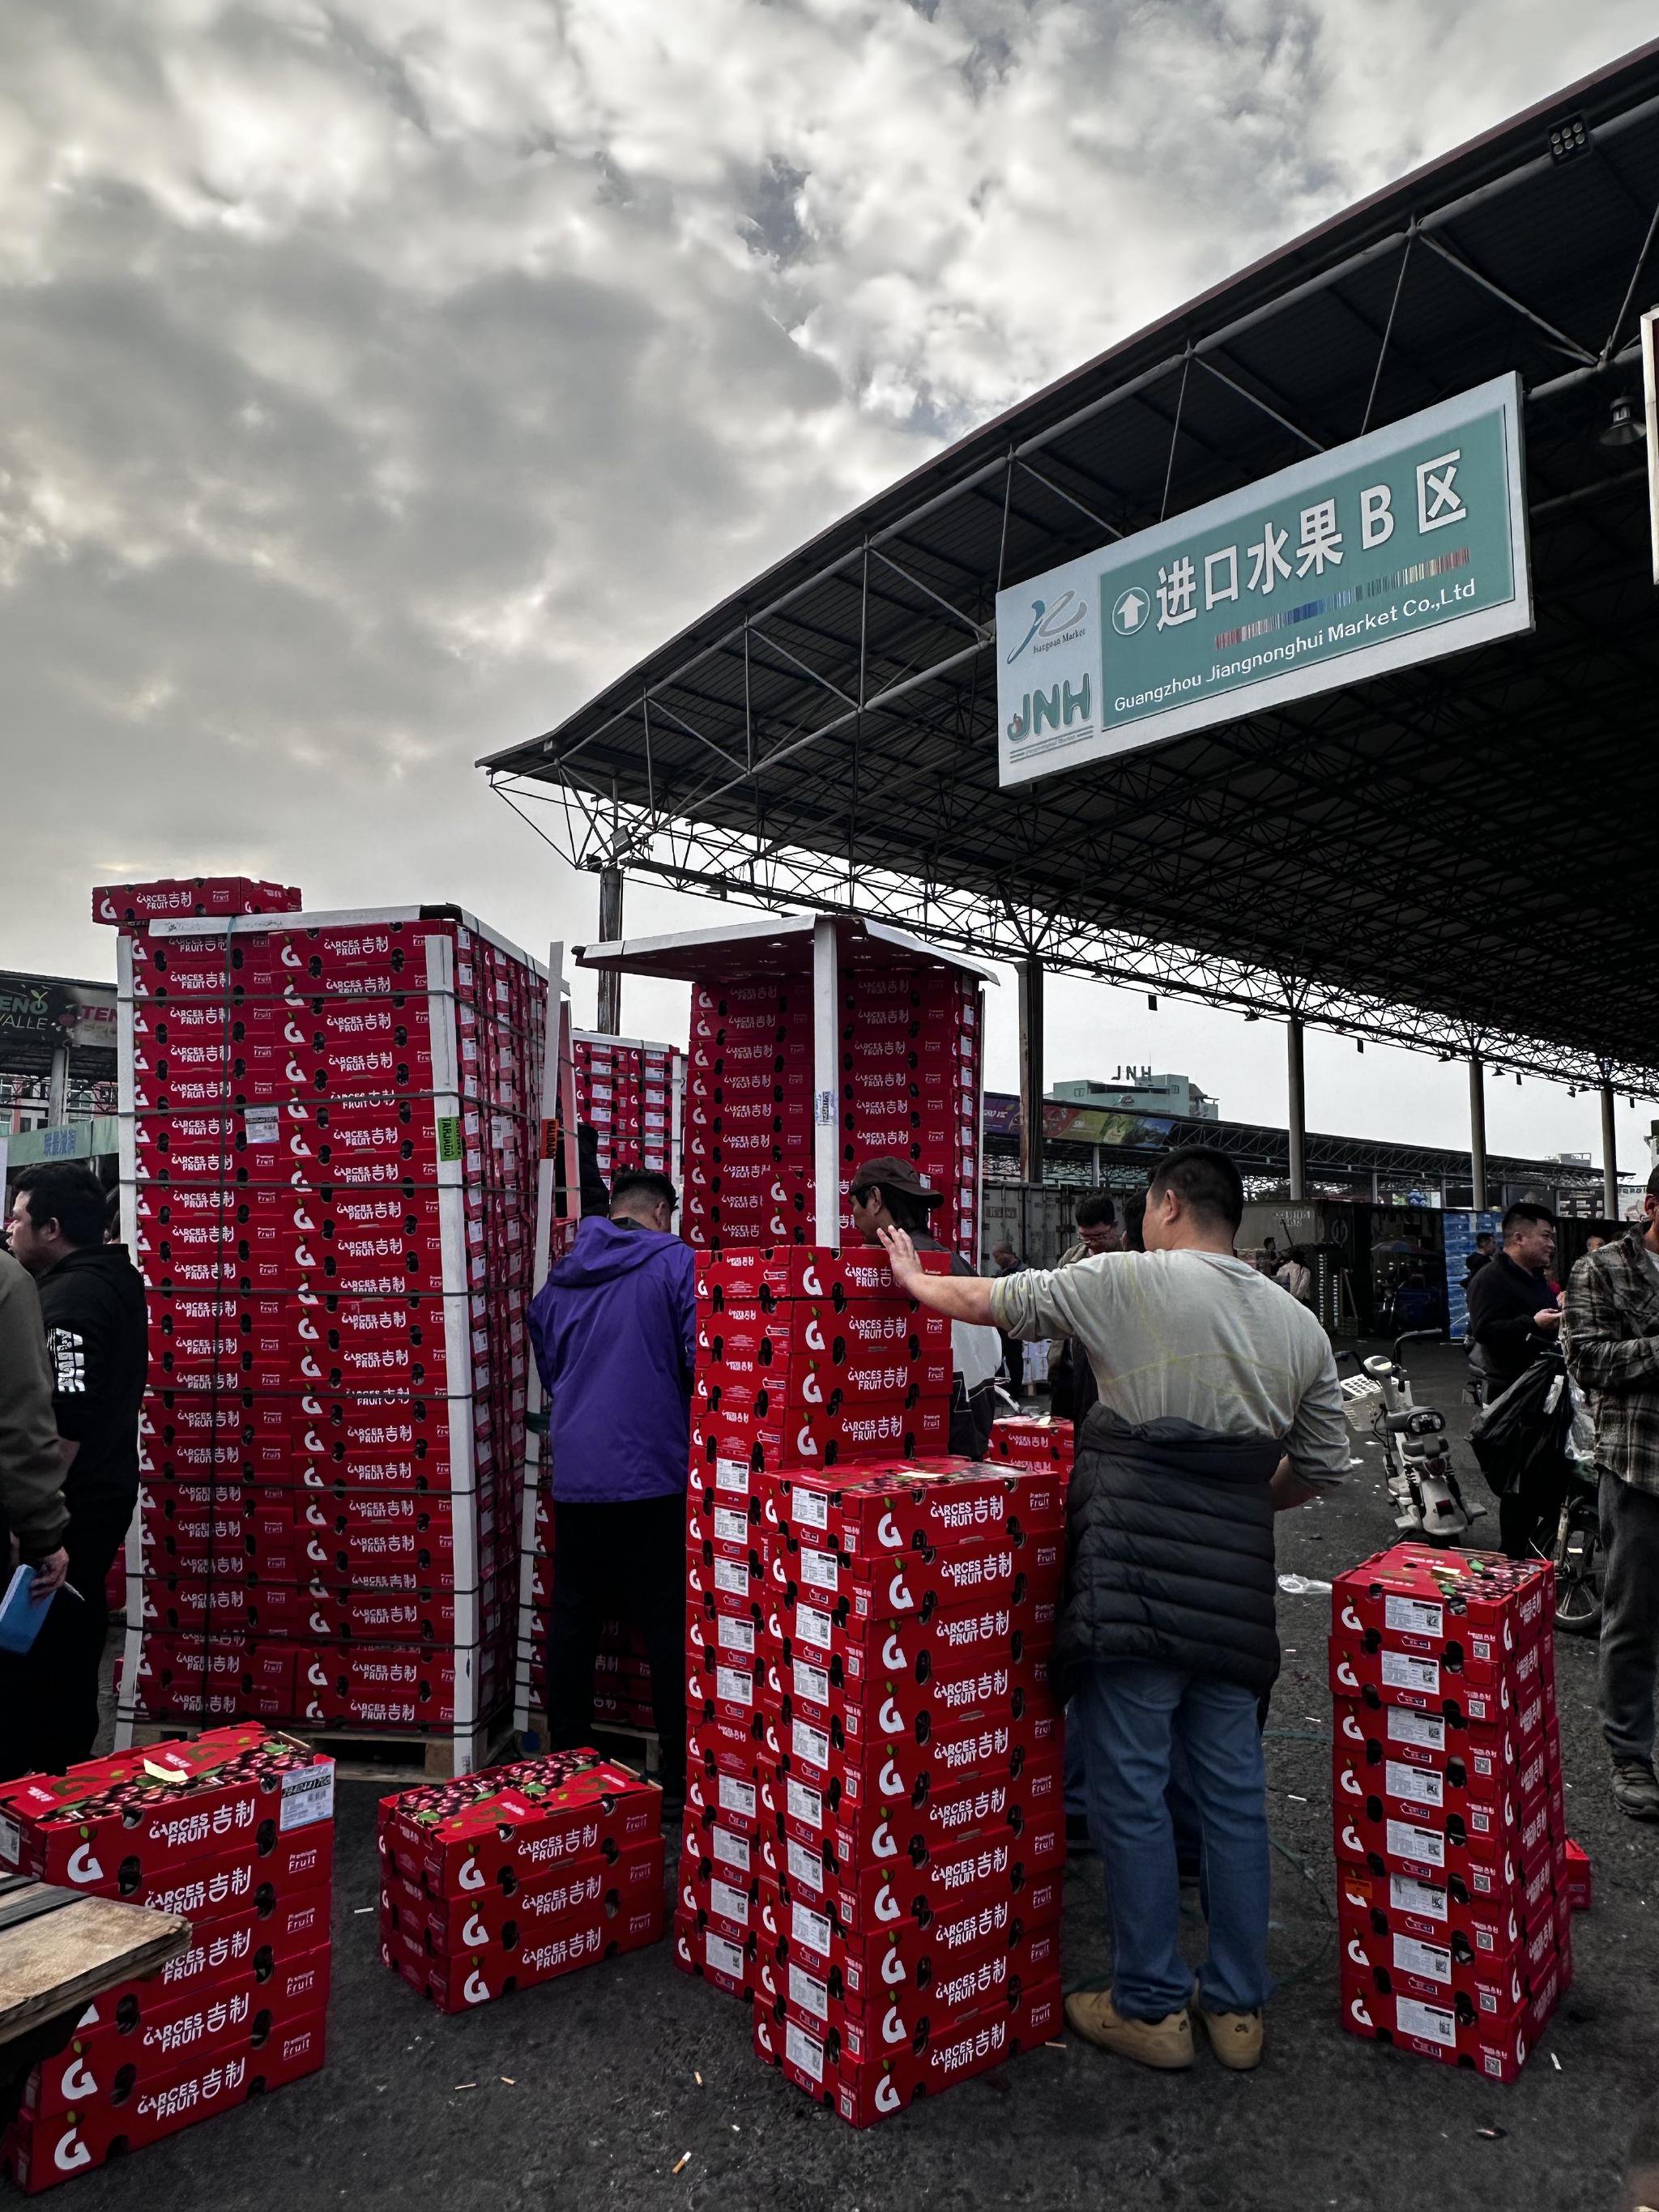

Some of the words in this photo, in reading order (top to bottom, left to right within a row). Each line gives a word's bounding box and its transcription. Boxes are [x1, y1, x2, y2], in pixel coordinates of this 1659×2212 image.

[1156, 498, 1344, 632] 进口水果
[1361, 484, 1395, 550] B
[1416, 450, 1466, 534] 区
[1115, 673, 1202, 713] Guangzhou
[1206, 630, 1324, 683] Jiangnonghui
[1328, 606, 1398, 643] Market
[1007, 673, 1091, 742] JNH
[1111, 1066, 1151, 1080] JNH
[856, 1276, 880, 1287] FRUIT
[859, 1328, 883, 1340] FRUIT
[859, 1379, 883, 1391] FRUIT
[854, 1430, 877, 1440] FRUIT
[945, 1513, 973, 1528] FRUIT
[955, 1571, 983, 1587] FRUIT
[950, 1630, 979, 1646] FRUIT
[948, 1690, 977, 1707] FRUIT
[949, 1750, 978, 1767] FRUIT
[943, 1810, 974, 1828] FRUIT
[168, 1825, 211, 1848] FRUIT
[531, 1844, 564, 1863] FRUIT
[945, 1869, 975, 1890] FRUIT
[164, 1893, 207, 1915] FRUIT
[535, 1897, 568, 1916] FRUIT
[949, 1927, 978, 1950] FRUIT
[536, 1950, 568, 1971] FRUIT
[164, 1958, 207, 1985] FRUIT
[948, 1983, 977, 2005] FRUIT
[161, 2023, 204, 2053] FRUIT
[944, 2049, 975, 2072] FRUIT
[157, 2091, 200, 2120] FRUIT
